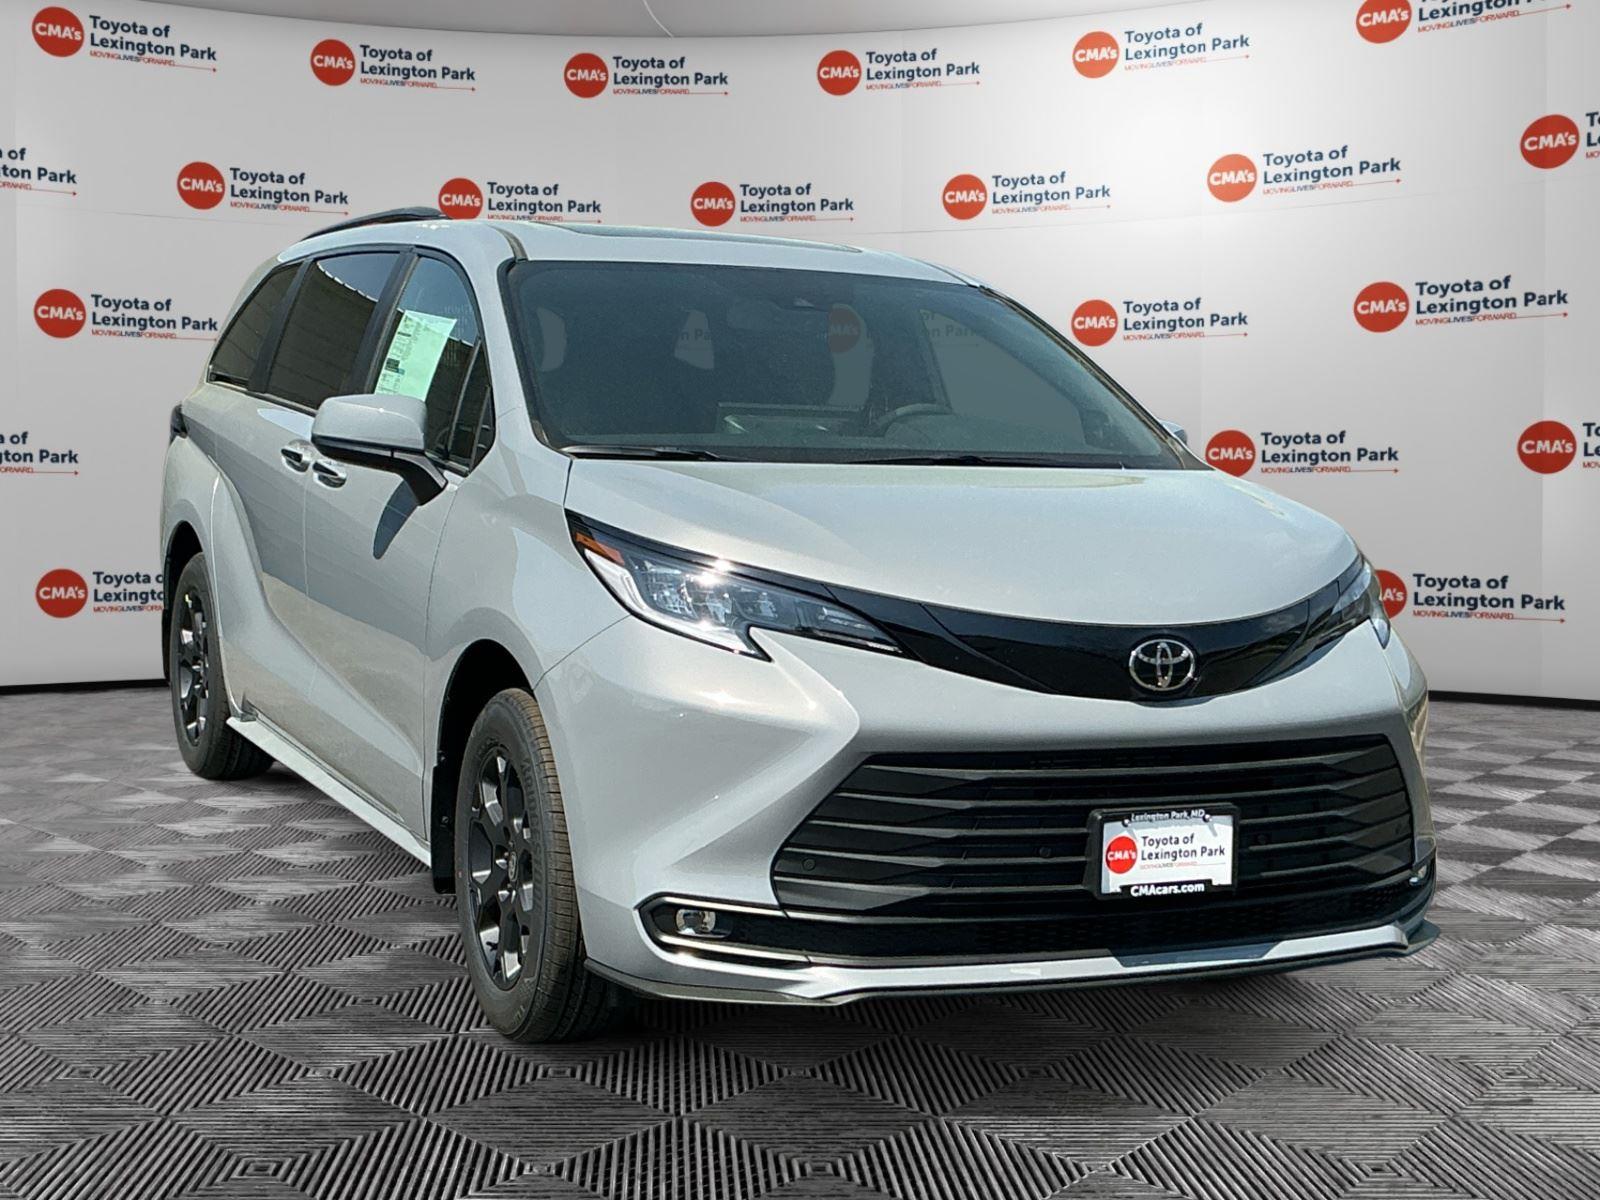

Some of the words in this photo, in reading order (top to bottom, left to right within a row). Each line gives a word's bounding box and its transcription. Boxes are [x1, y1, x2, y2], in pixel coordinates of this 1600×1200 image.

[1358, 7, 1410, 29] CMA's
[34, 22, 83, 41] CMA's
[89, 15, 148, 35] Toyota
[152, 25, 170, 38] of
[1125, 28, 1180, 44] Toyota
[1186, 23, 1202, 36] of
[91, 33, 174, 56] Lexington
[180, 44, 216, 60] Park
[360, 44, 412, 62] Toyota
[416, 50, 432, 61] of
[1126, 44, 1205, 60] Lexington
[1212, 35, 1249, 50] Park
[312, 55, 354, 69] CMA's
[866, 51, 916, 66] Toyota
[921, 48, 936, 60] of
[1074, 47, 1118, 63] CMA's
[361, 61, 436, 80] Lexington
[442, 66, 475, 80] Park
[613, 56, 665, 72] Toyota
[669, 56, 685, 69] of
[867, 67, 941, 81] Lexington
[947, 62, 979, 76] Park
[566, 69, 607, 82] CMA's
[614, 72, 689, 88] Lexington
[694, 72, 728, 84] Park
[819, 66, 860, 79] CMA's
[1524, 132, 1576, 151] CMA's
[8, 148, 26, 160] of
[1264, 150, 1323, 168] Toyota
[1329, 145, 1348, 159] of
[38, 167, 76, 184] Park
[230, 168, 284, 185] Toyota
[289, 173, 305, 184] of
[1209, 169, 1255, 186] CMA's
[1264, 166, 1352, 184] Lexington
[1360, 158, 1400, 174] Park
[180, 178, 223, 193] CMA's
[992, 174, 1044, 190] Toyota
[1050, 172, 1065, 184] of
[231, 184, 310, 204] Lexington
[315, 190, 348, 204] Park
[487, 182, 538, 198] Toyota
[543, 184, 558, 195] of
[740, 184, 791, 199] Toyota
[795, 183, 811, 195] of
[944, 190, 985, 204] CMA's
[993, 190, 1069, 205] Lexington
[1076, 186, 1109, 198] Park
[440, 193, 481, 208] CMA's
[488, 198, 562, 214] Lexington
[568, 200, 600, 212] Park
[693, 197, 734, 211] CMA's
[741, 200, 815, 215] Lexington
[821, 198, 853, 210] Park
[1416, 280, 1483, 298] Toyota
[1489, 275, 1511, 290] of
[91, 294, 149, 312] Toyota
[154, 299, 172, 311] of
[1124, 300, 1178, 316] Toyota
[1184, 298, 1200, 310] of
[1357, 299, 1407, 315] CMA's
[1416, 297, 1516, 314] Lexington
[1524, 290, 1568, 307] Park
[36, 305, 84, 321] CMA's
[92, 312, 176, 331] Lexington
[182, 316, 218, 331] Park
[1073, 315, 1116, 329] CMA's
[1124, 317, 1204, 332] Lexington
[1210, 312, 1247, 326] Park
[10, 432, 28, 444] of
[1261, 432, 1321, 448] Toyota
[1326, 430, 1346, 444] of
[1207, 445, 1253, 461] CMA's
[1521, 439, 1574, 454] CMA's
[40, 449, 78, 463] Park
[1262, 449, 1350, 466] Lexington
[1357, 447, 1398, 461] Park
[93, 572, 151, 588] Toyota
[1413, 574, 1480, 592] Toyota
[1486, 576, 1508, 589] of
[38, 585, 86, 600] CMA's
[94, 588, 164, 604] Lexingt
[1381, 588, 1404, 602] A's
[1414, 592, 1514, 611] Lexington
[1521, 594, 1564, 610] Park
[1131, 813, 1169, 822] Lexington
[1142, 836, 1180, 849] Toyota
[1183, 833, 1195, 845] of
[1107, 850, 1137, 861] CMA's
[1141, 848, 1197, 861] Lexington
[1200, 845, 1225, 857] Park
[1130, 882, 1205, 897] CMAcars.com
